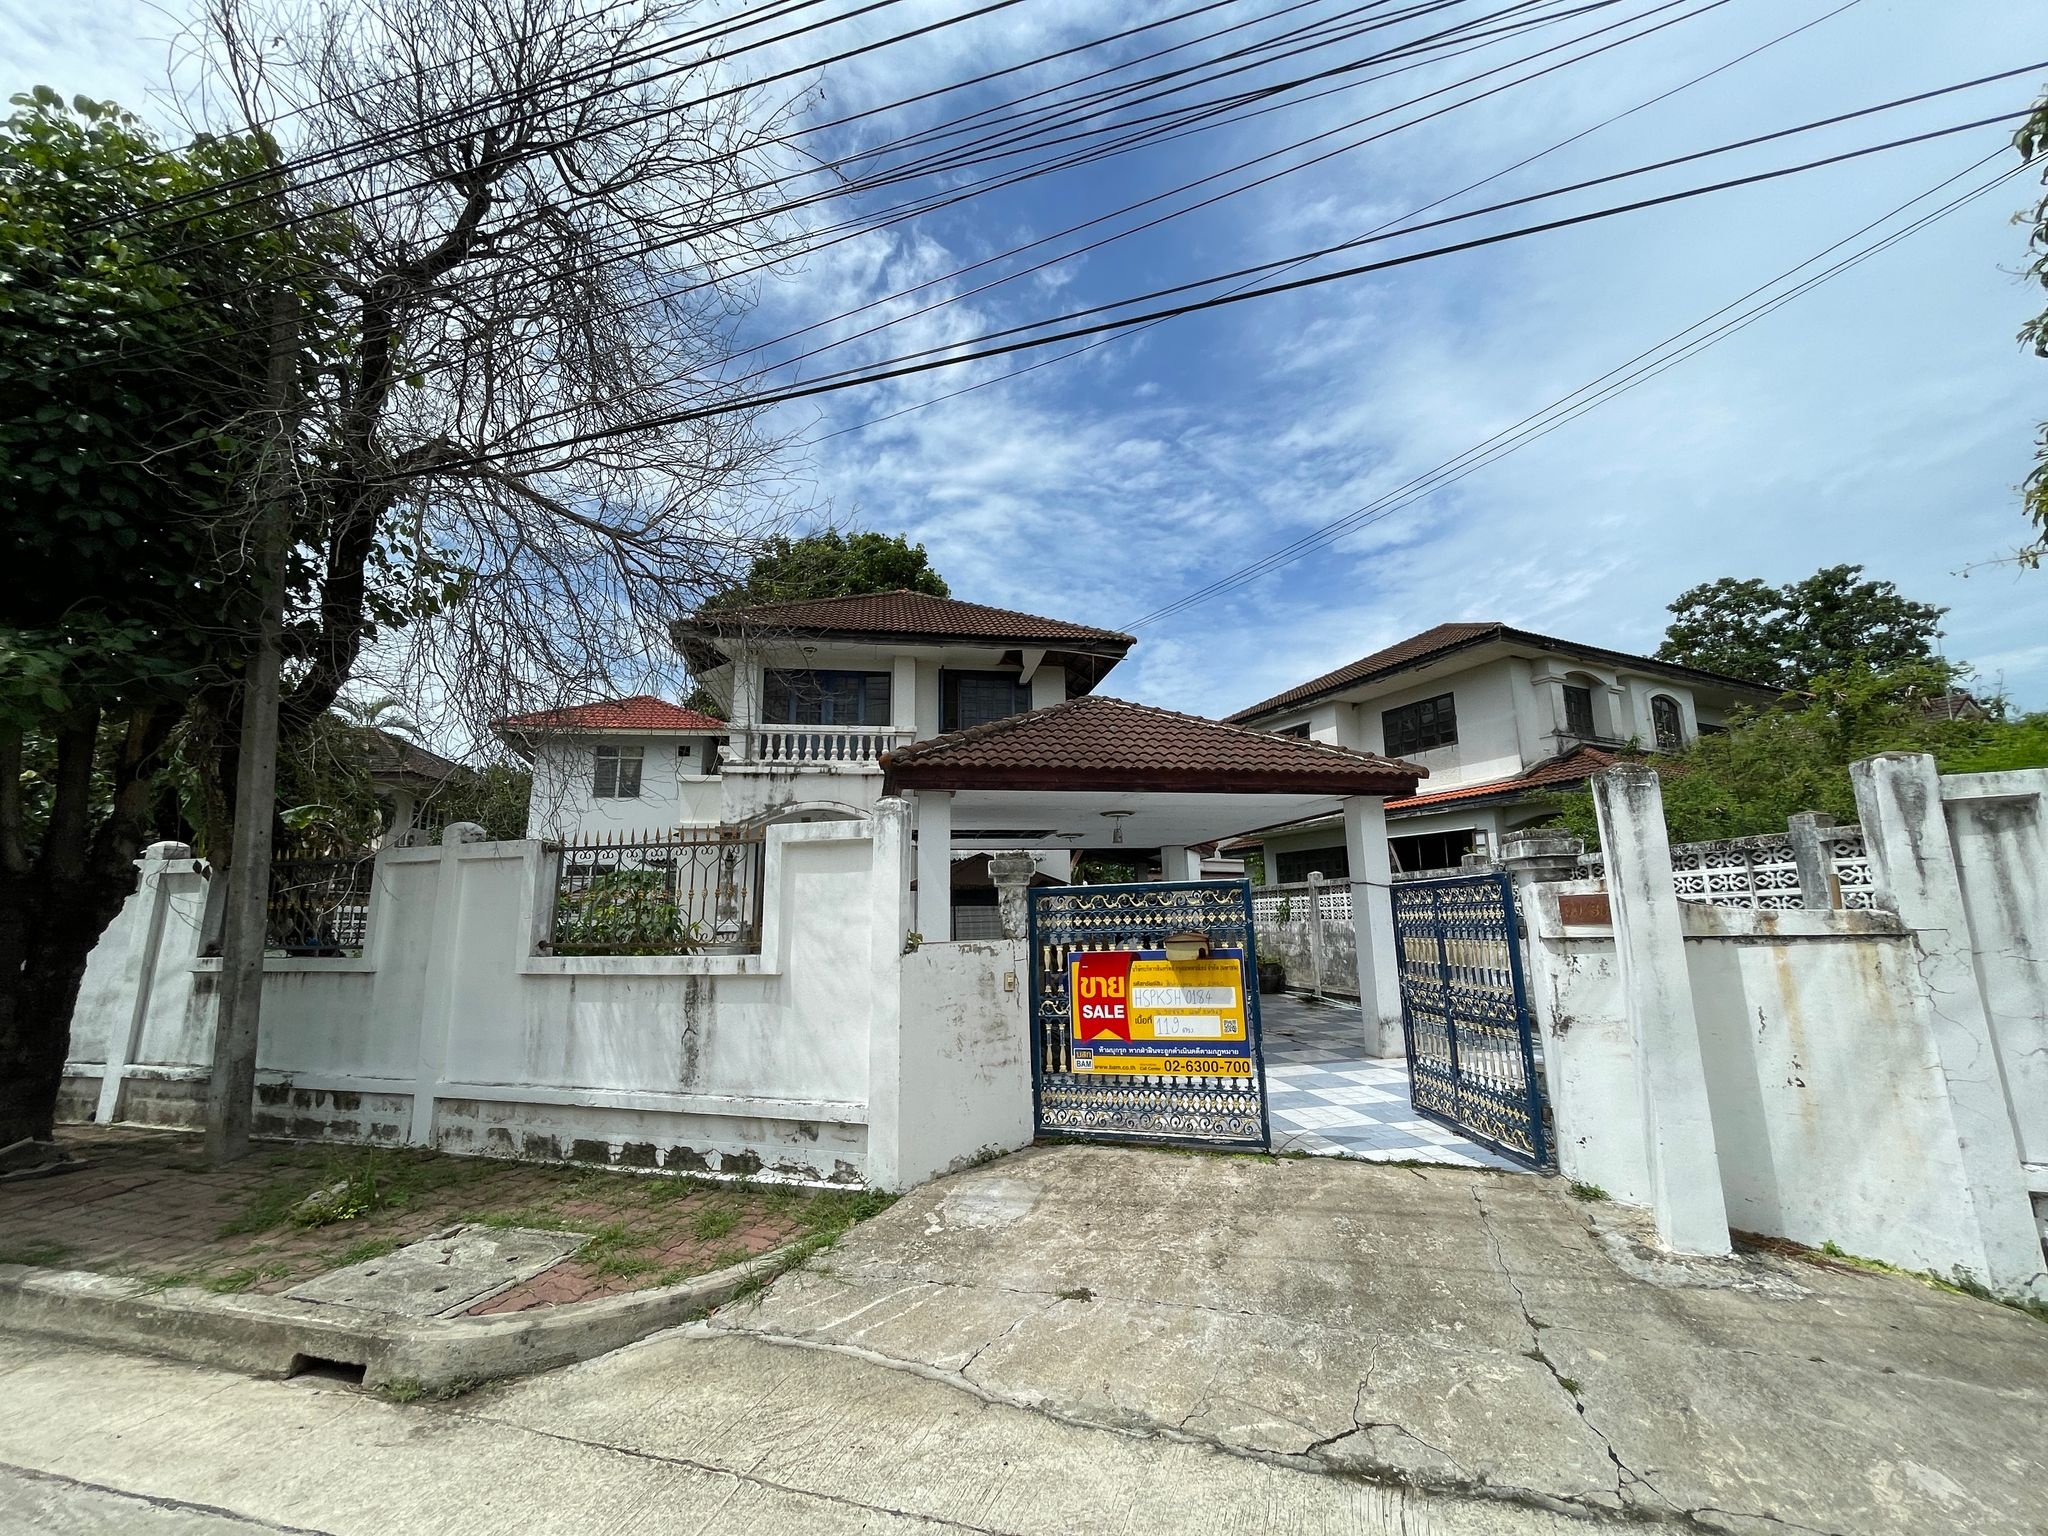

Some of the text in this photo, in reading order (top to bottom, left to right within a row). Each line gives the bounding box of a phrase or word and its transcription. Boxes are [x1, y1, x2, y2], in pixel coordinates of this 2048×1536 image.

[1080, 976, 1125, 999] ขาย
[1135, 988, 1212, 1007] HSPKSH 0184
[1082, 1004, 1125, 1019] SALE
[1135, 1014, 1153, 1025] เนื้อที่
[1098, 1046, 1127, 1056] ห้ามบุกรุก
[1076, 1060, 1092, 1068] BAM
[1163, 1060, 1250, 1073] 02-6300-700
